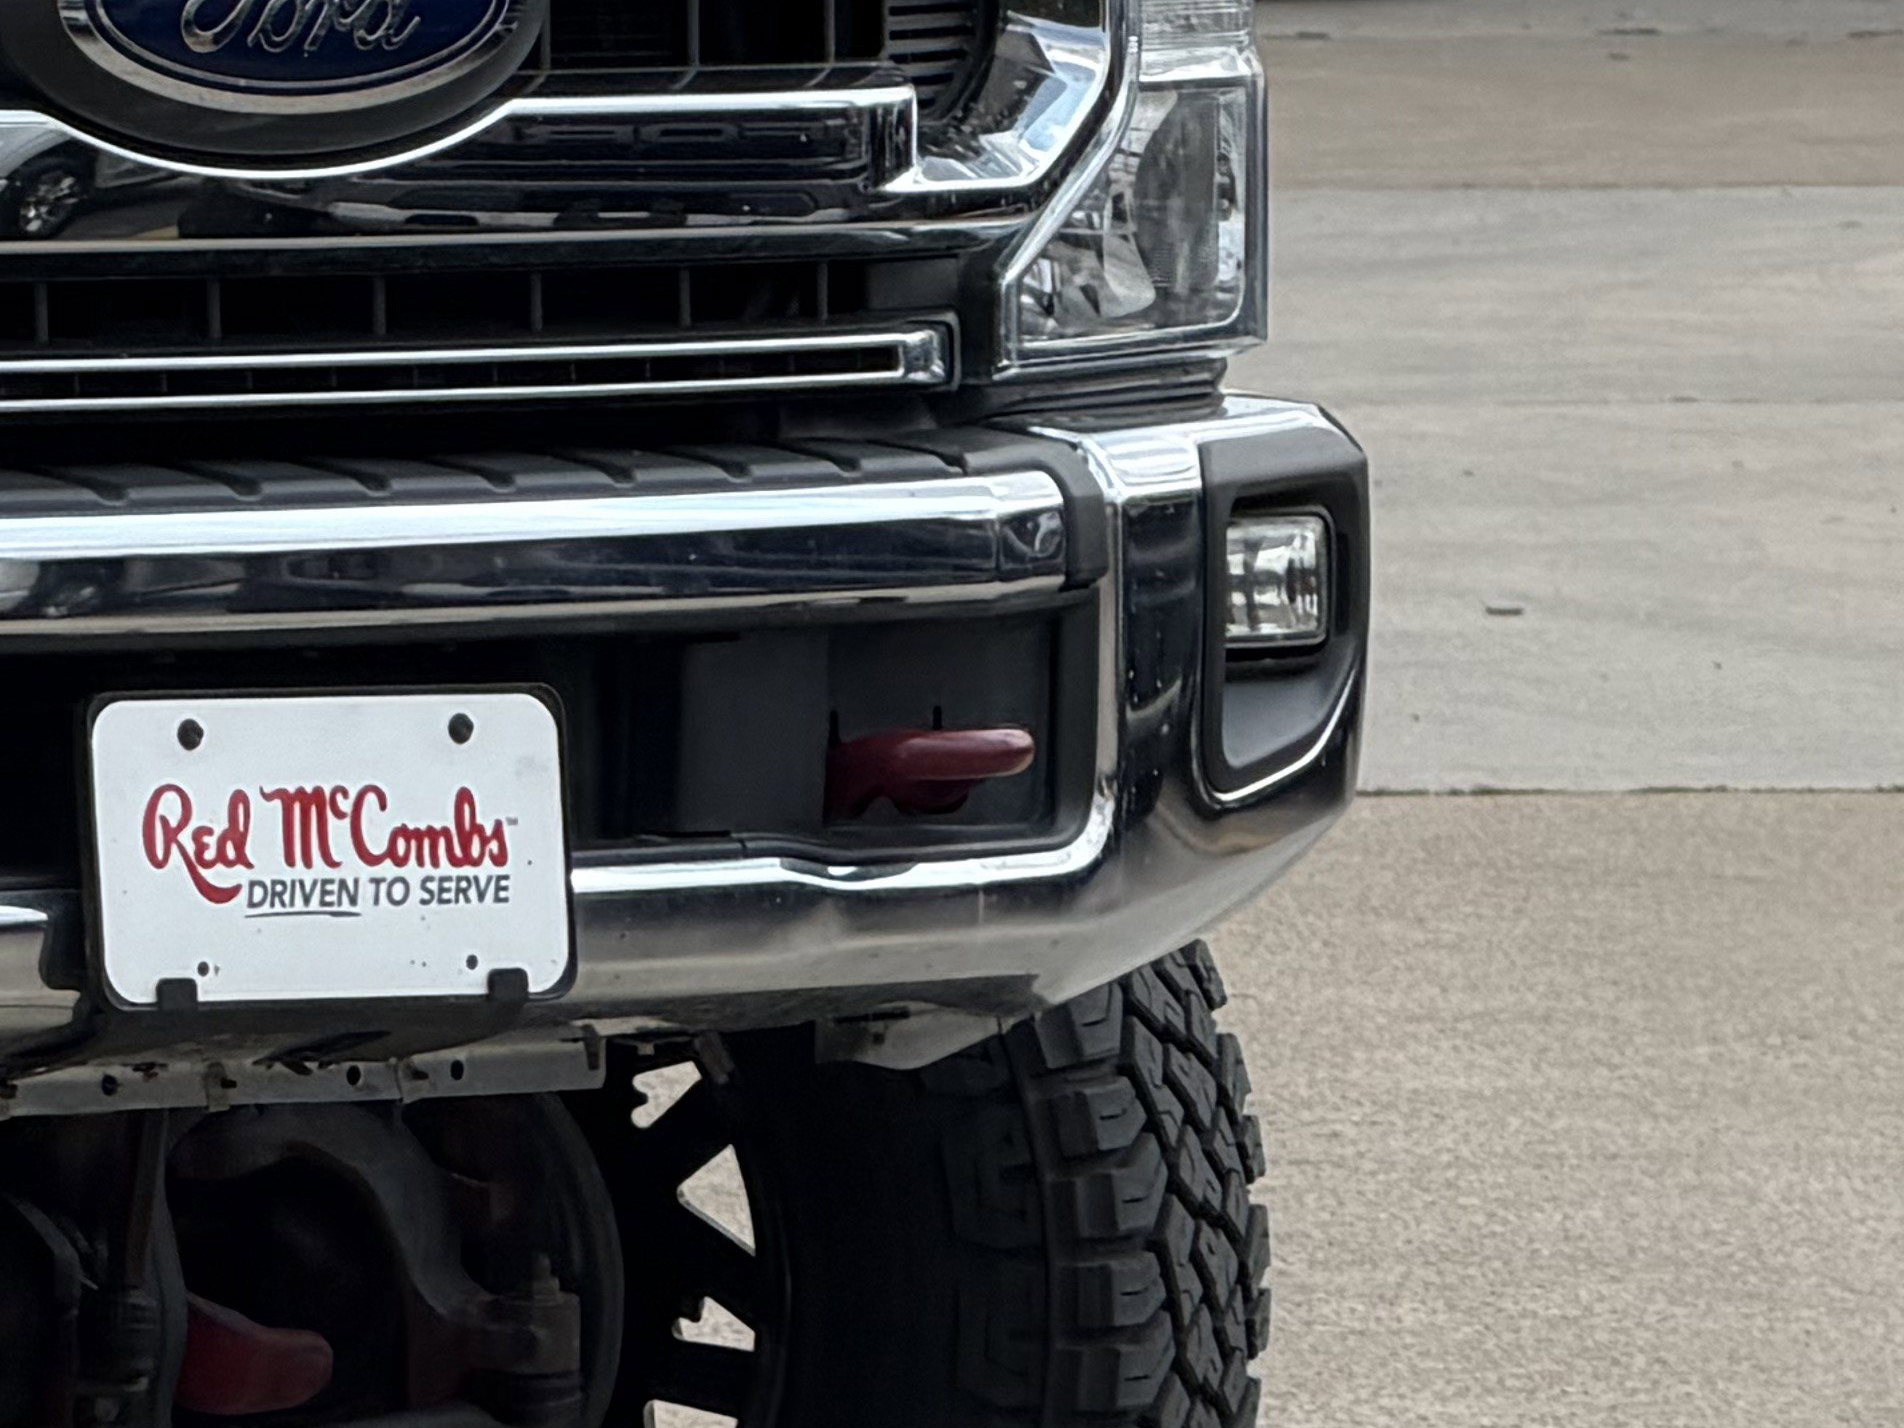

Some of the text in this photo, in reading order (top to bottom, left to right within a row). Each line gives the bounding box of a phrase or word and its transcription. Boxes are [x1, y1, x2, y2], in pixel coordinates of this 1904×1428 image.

[142, 782, 255, 905] Red
[247, 873, 511, 909] DRIVEN TO SERVE
